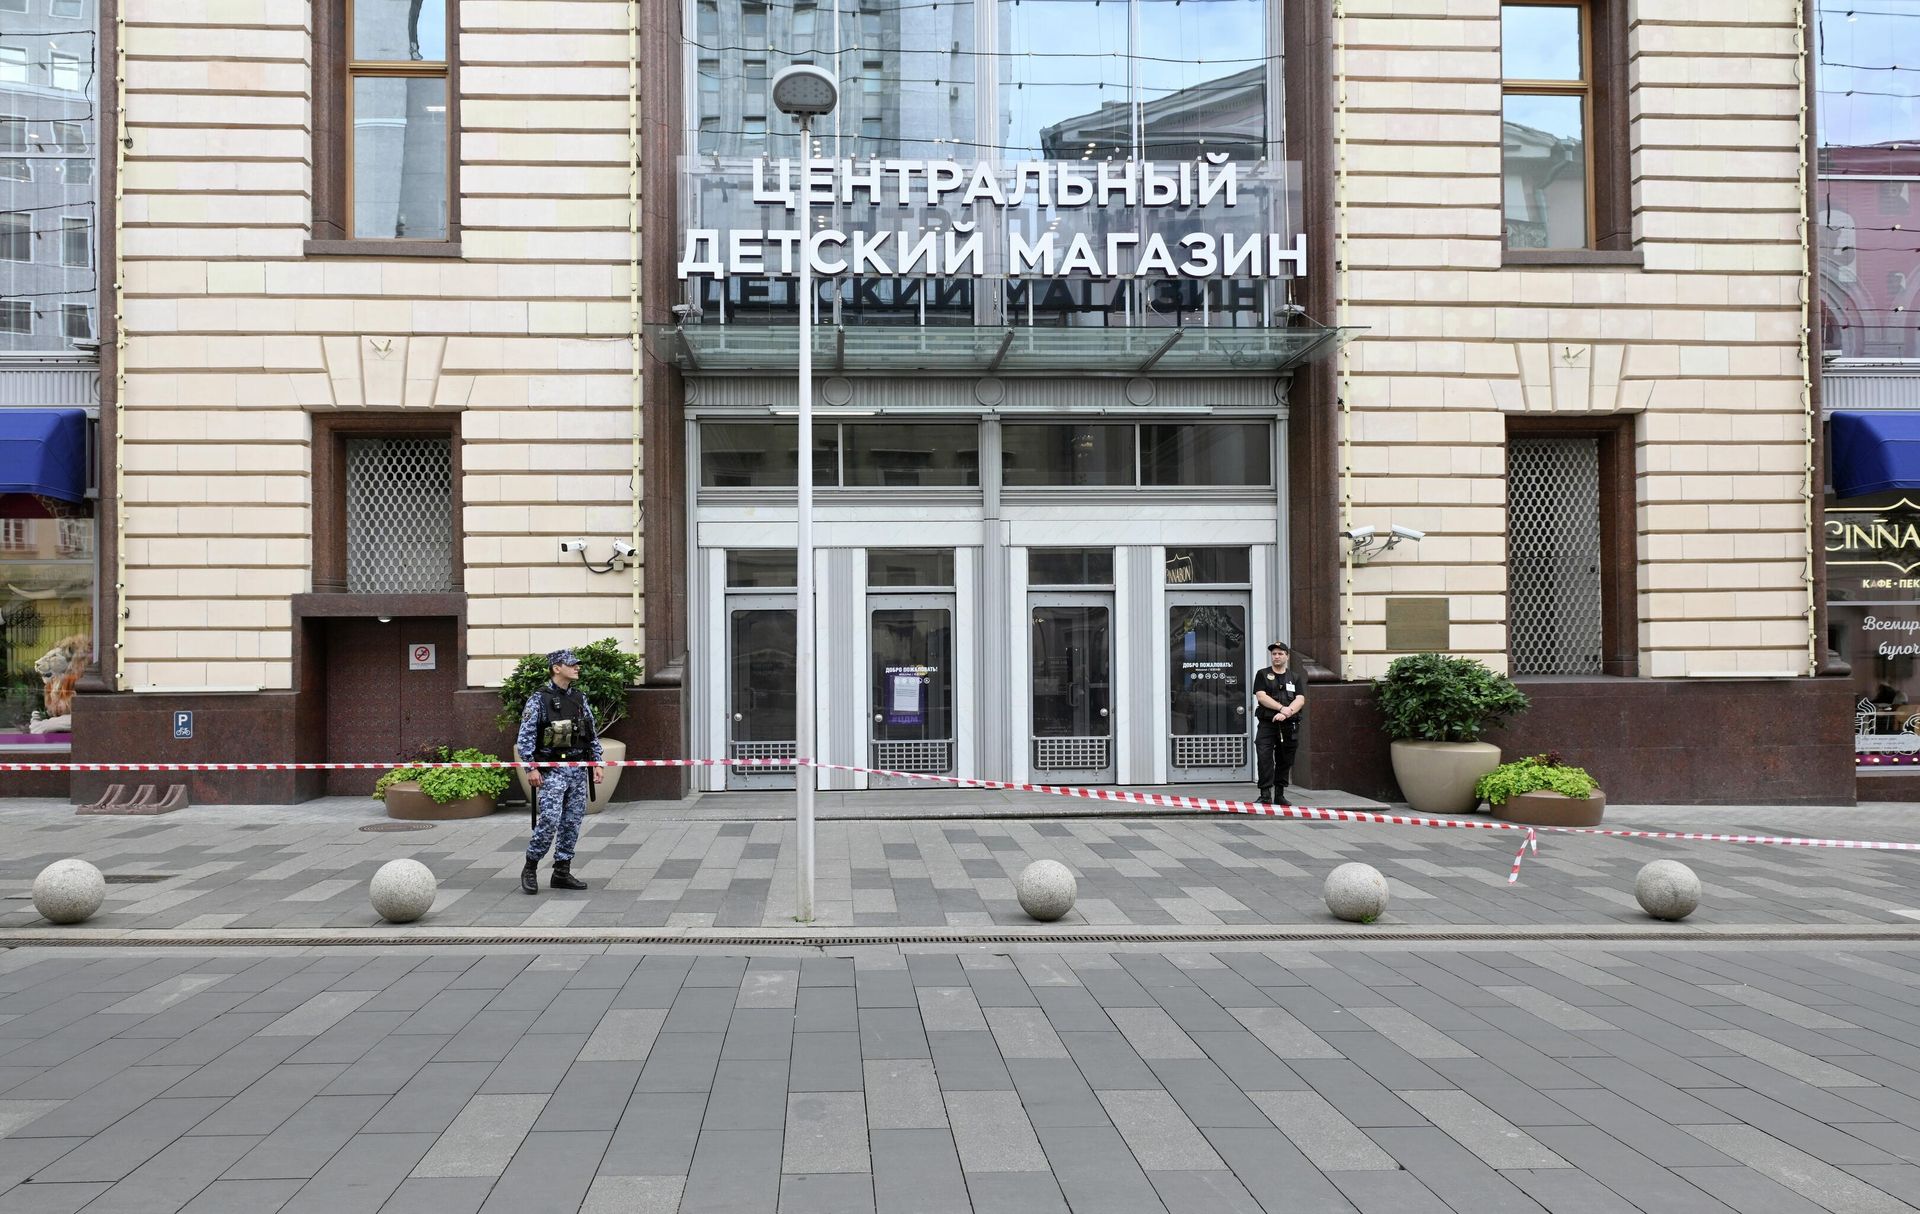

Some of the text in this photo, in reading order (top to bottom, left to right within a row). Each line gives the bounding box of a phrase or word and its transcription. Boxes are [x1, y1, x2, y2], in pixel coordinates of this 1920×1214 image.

[753, 152, 1237, 209] ЦЕНТРАЛЬНЫЙ
[677, 221, 1308, 280] ДЕТСКИЙ МАГАЗИН
[1862, 579, 1920, 589] КАФЕ ПЕК
[178, 714, 188, 726] P
